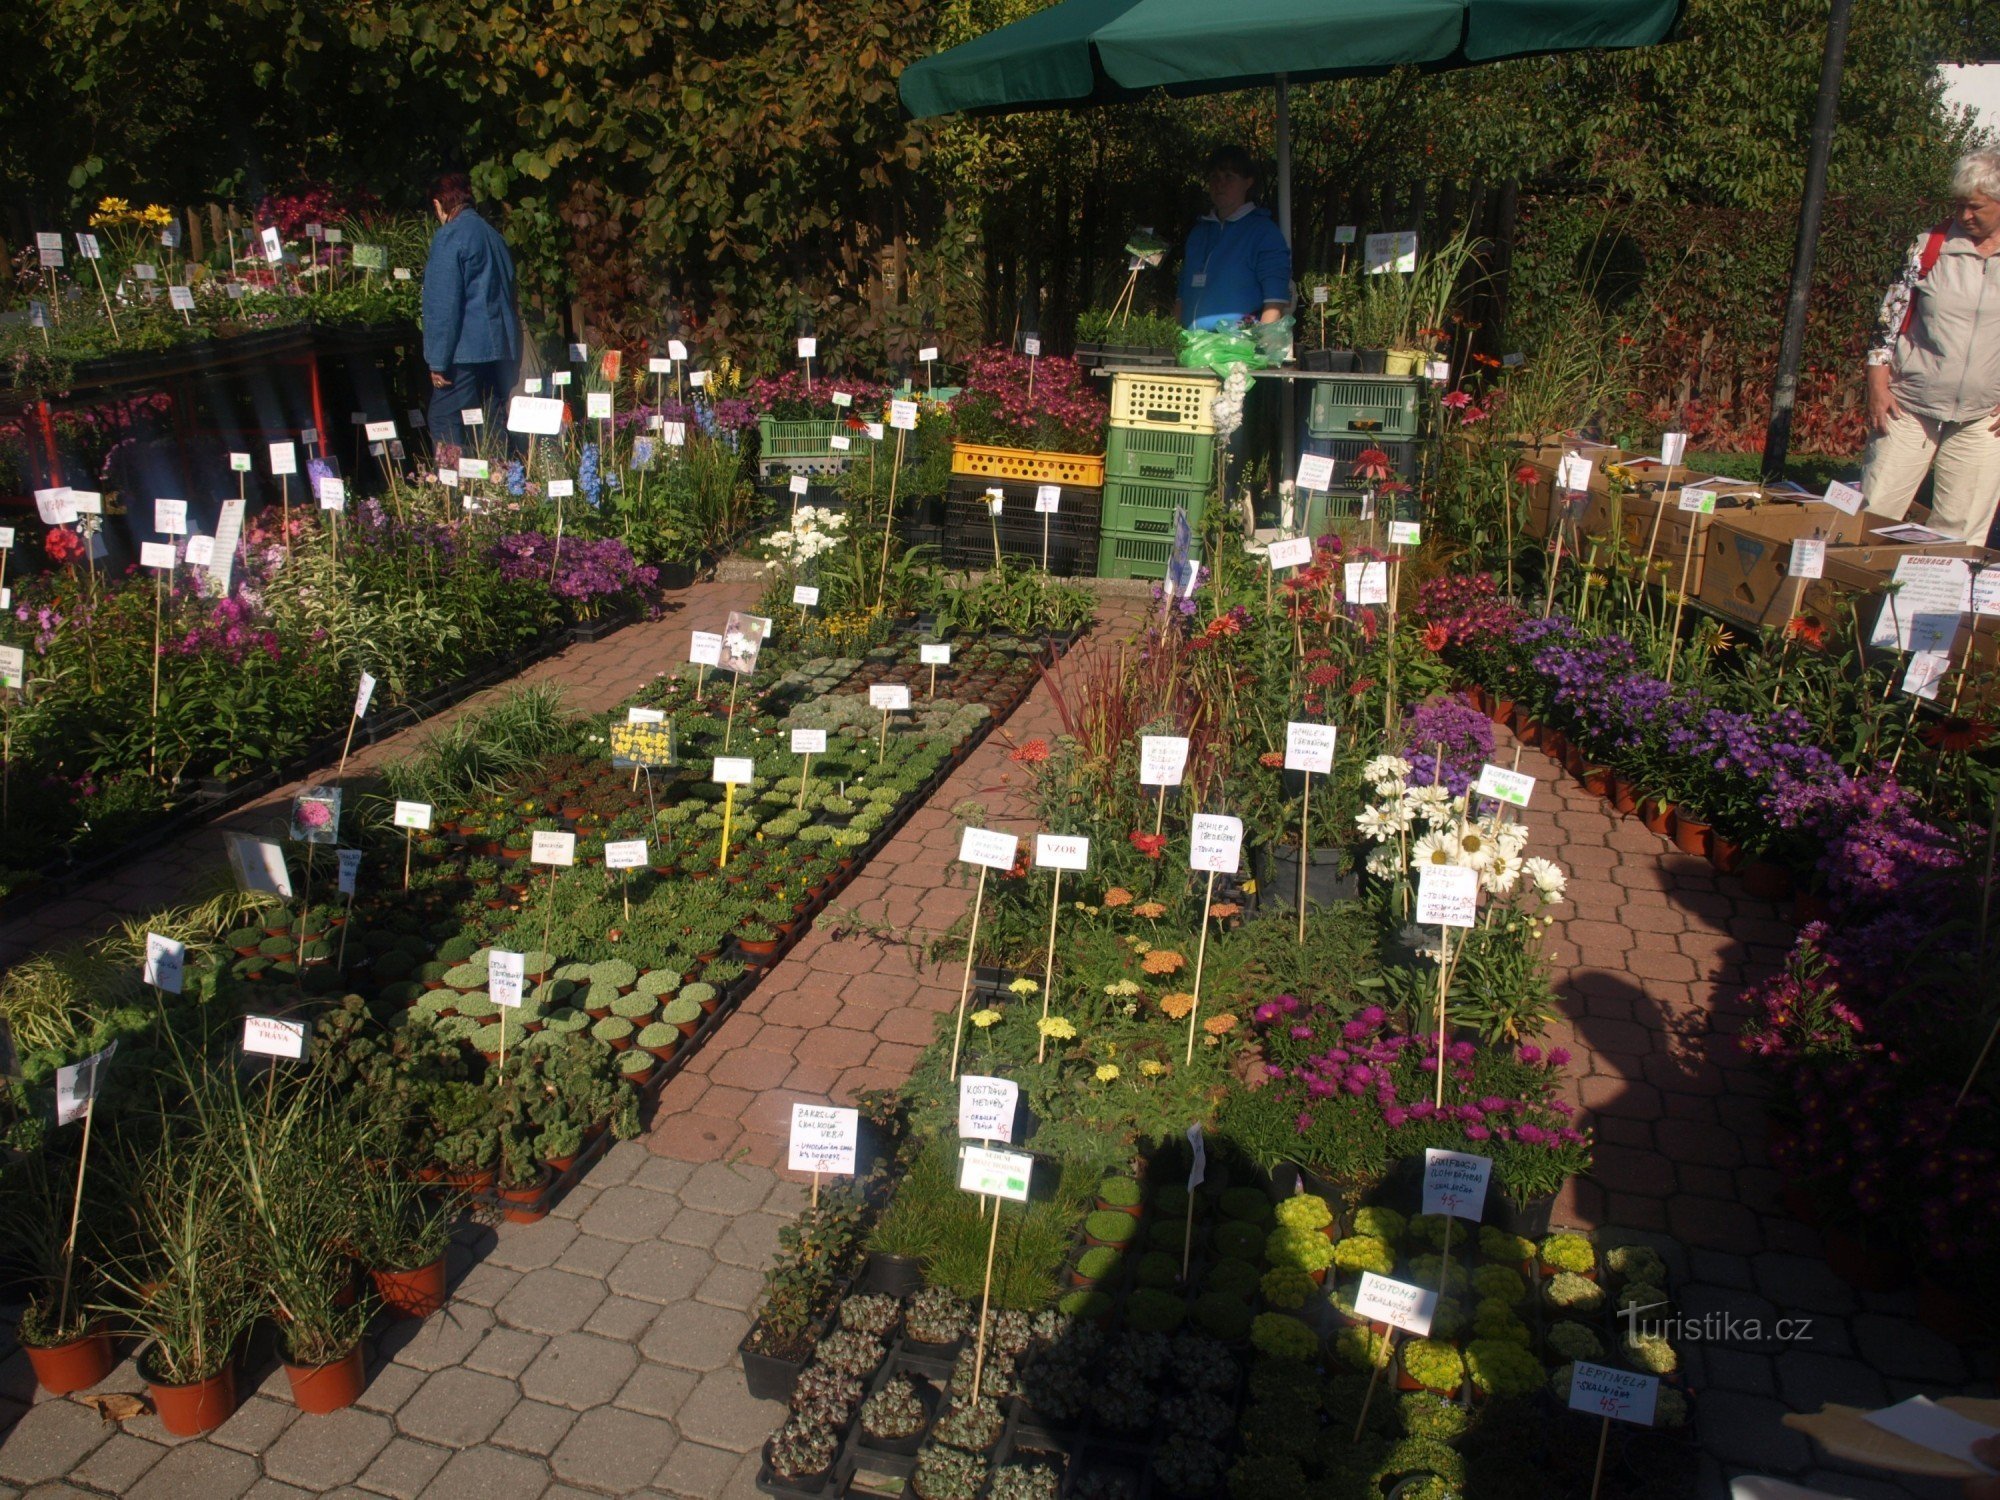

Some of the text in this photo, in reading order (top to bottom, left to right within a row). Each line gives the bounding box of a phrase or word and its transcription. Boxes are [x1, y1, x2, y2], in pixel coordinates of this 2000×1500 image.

[1907, 556, 1953, 566] ECHINACEA
[1047, 843, 1077, 855] VZOR
[821, 1130, 844, 1139] VRBA
[1430, 1155, 1477, 1170] SAXIFRAGA
[1368, 1277, 1418, 1300] ISOTOMA
[1578, 1364, 1647, 1390] LEPTINELA
